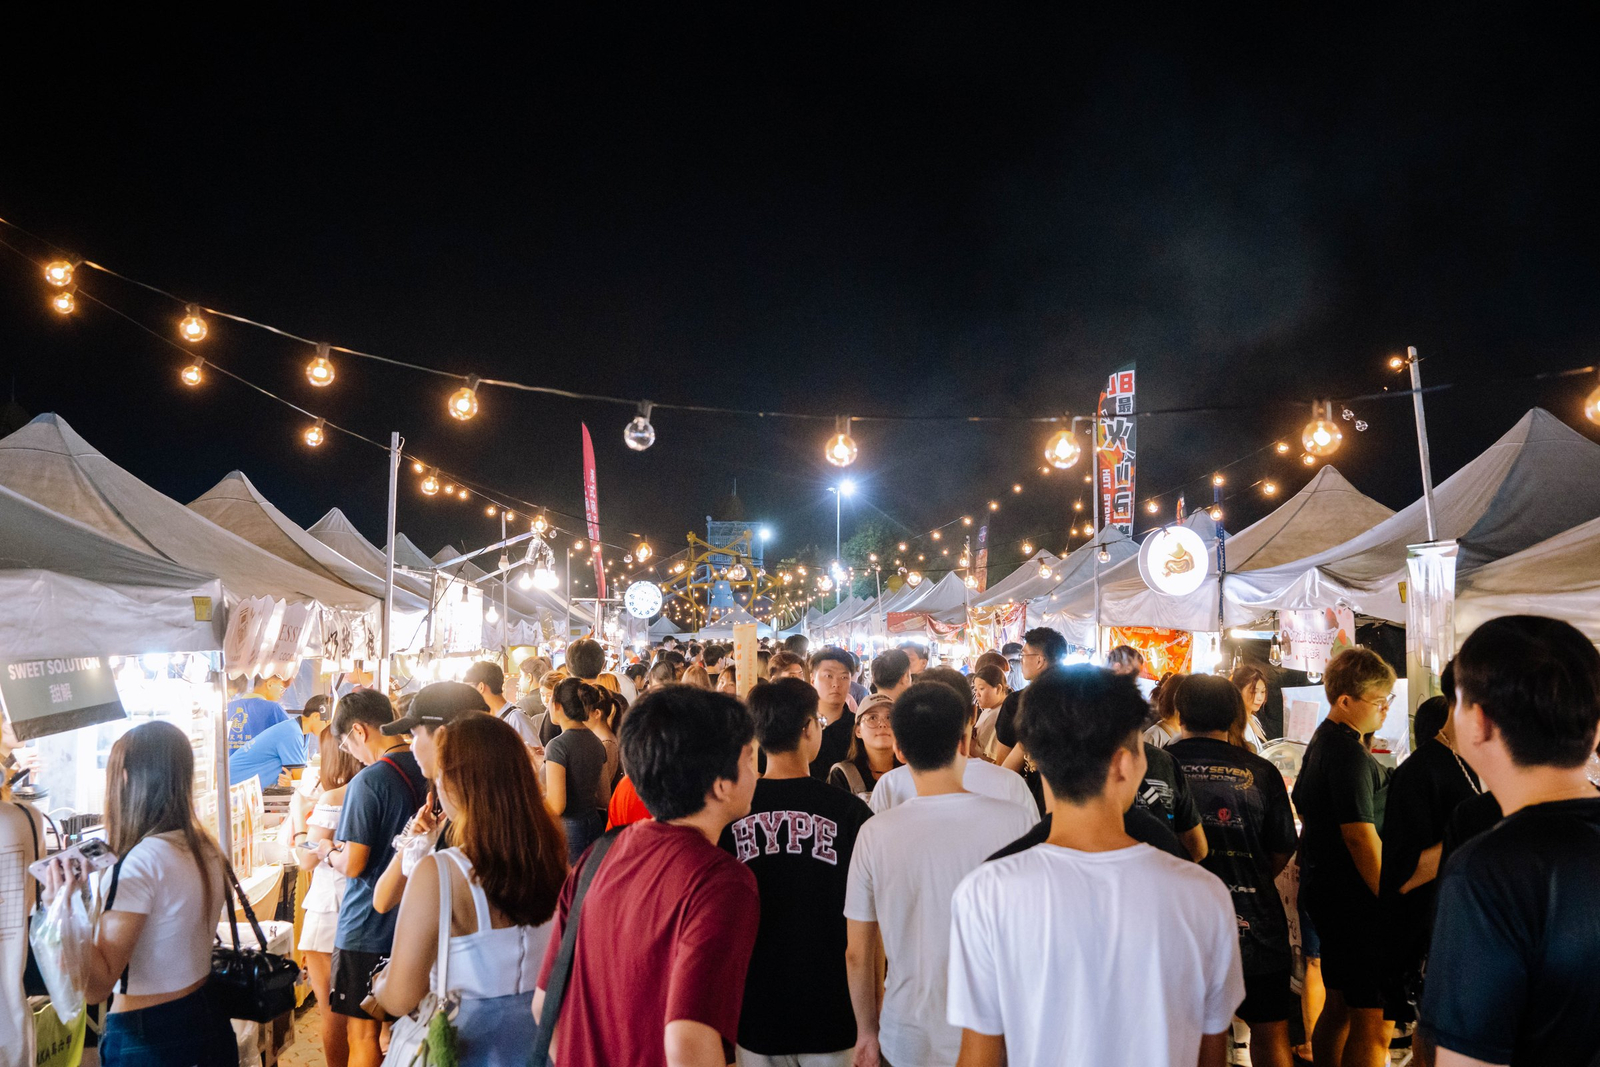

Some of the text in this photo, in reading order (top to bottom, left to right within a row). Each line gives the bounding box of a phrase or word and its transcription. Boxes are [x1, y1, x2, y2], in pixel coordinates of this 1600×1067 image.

[1107, 370, 1135, 398] JB
[1102, 468, 1112, 490] HOT
[8, 657, 101, 681] SWEET SOLUTION
[732, 811, 837, 865] HYPE
